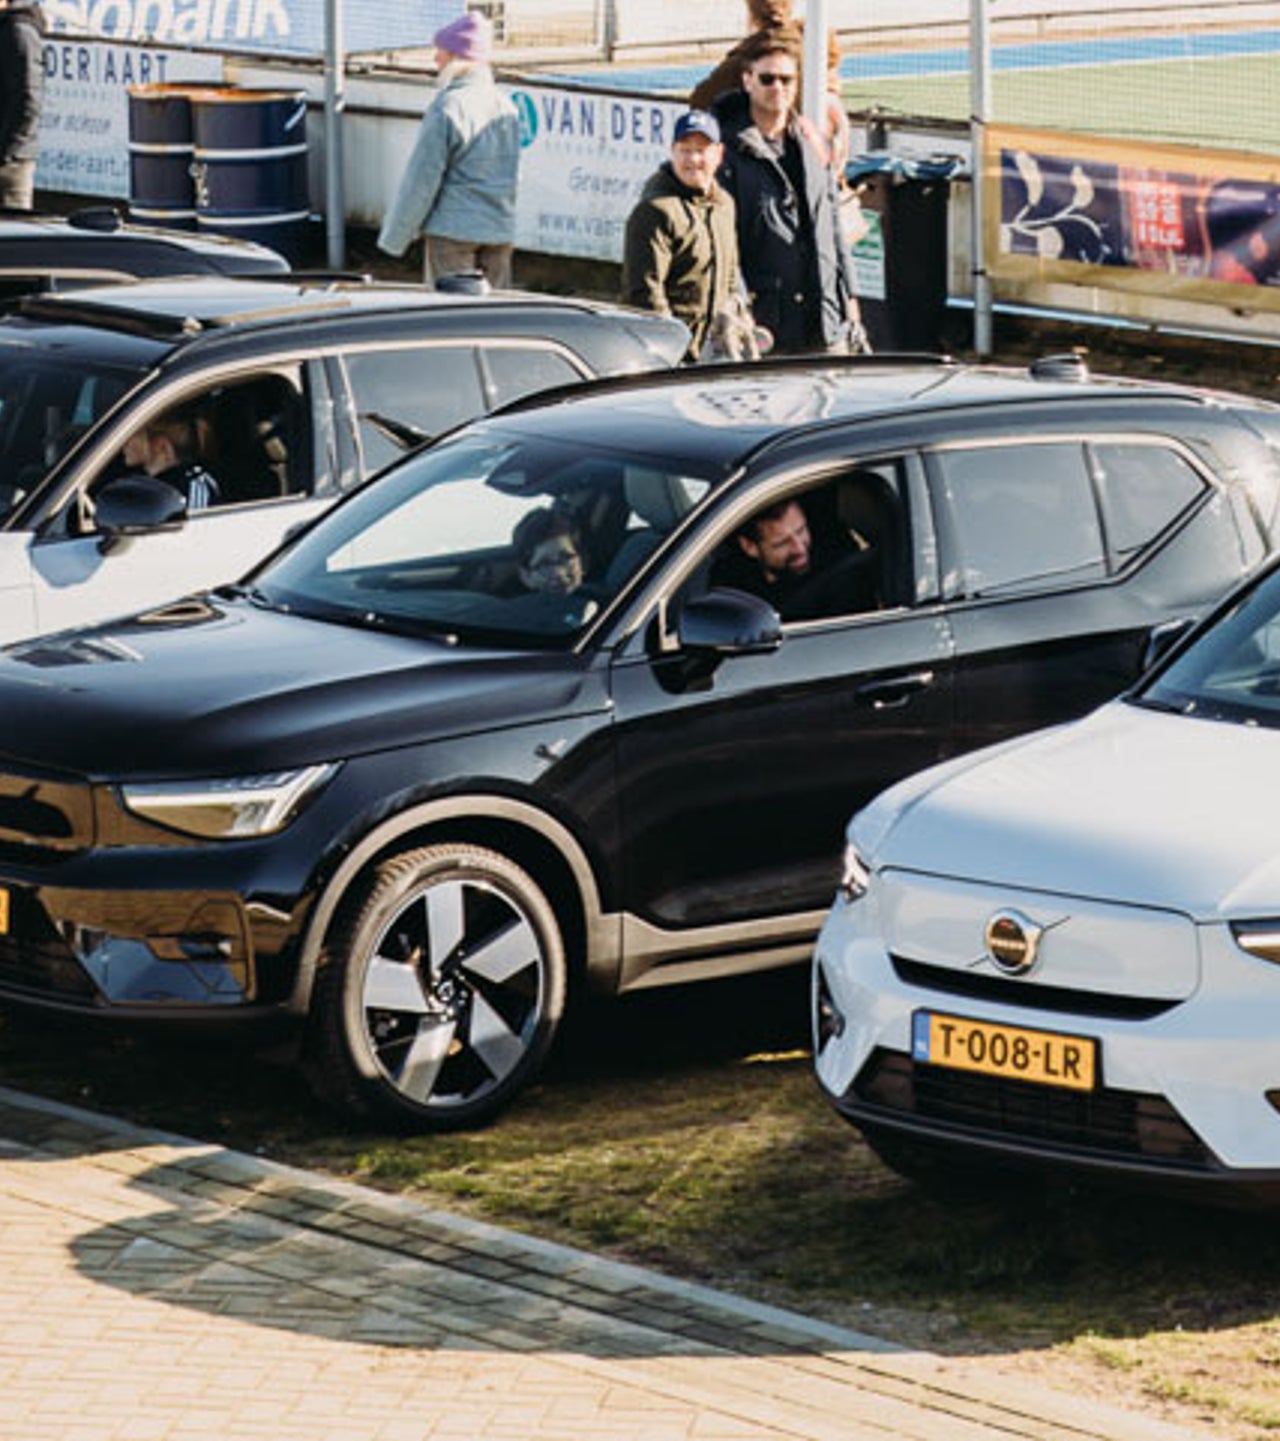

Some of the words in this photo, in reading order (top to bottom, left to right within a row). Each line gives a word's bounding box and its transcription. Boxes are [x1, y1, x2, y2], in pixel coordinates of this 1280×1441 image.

[104, 49, 168, 85] AART
[542, 95, 595, 136] VAN
[611, 103, 664, 145] DER
[937, 1022, 1082, 1080] T-008-LR
